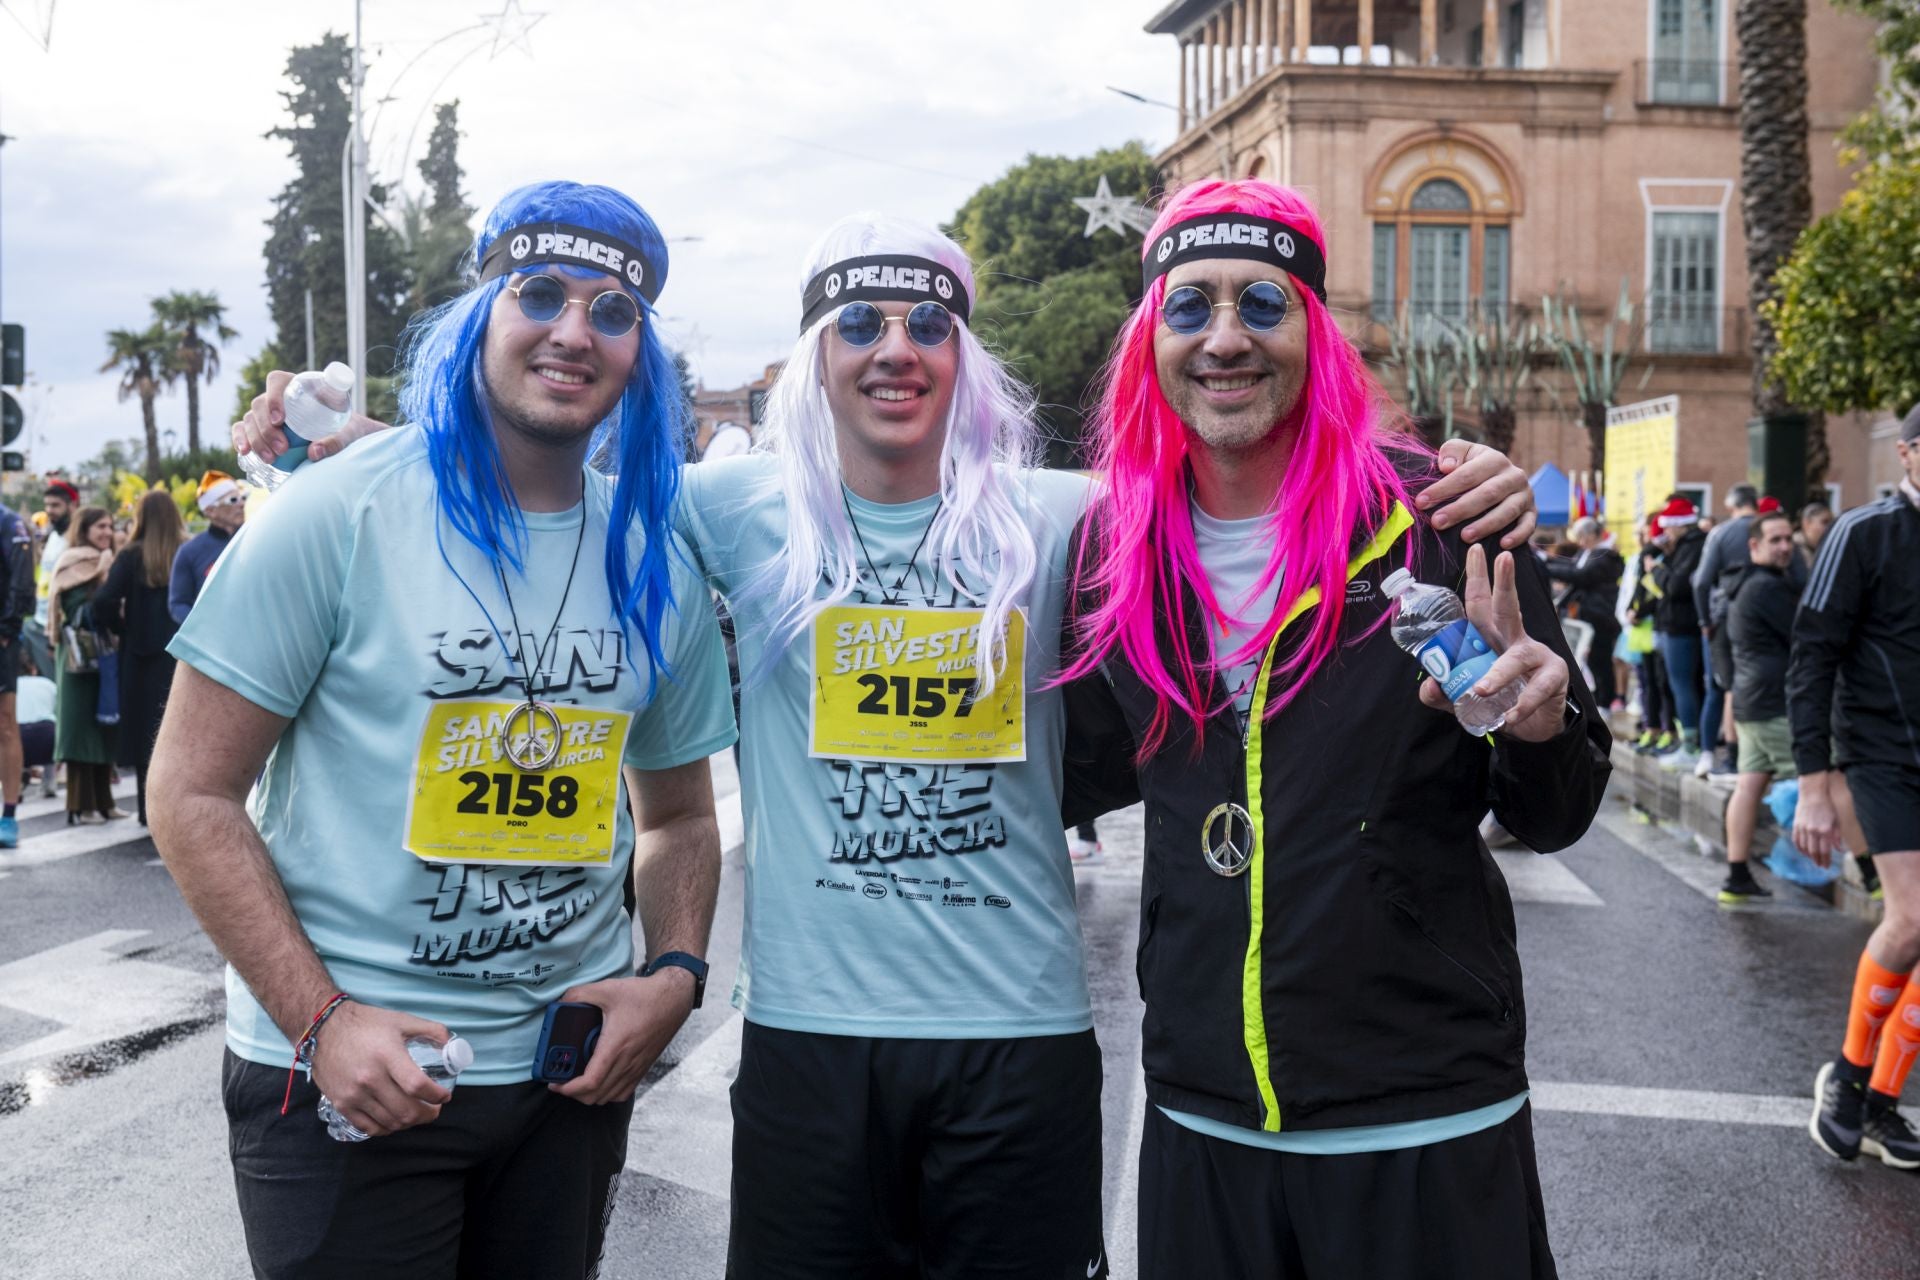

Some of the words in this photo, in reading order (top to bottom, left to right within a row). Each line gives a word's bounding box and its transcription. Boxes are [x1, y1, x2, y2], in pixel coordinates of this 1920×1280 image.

[535, 233, 624, 272] PEACE
[1178, 223, 1268, 251] PEACE
[846, 266, 930, 292] PEACE
[834, 616, 906, 648] SAN
[425, 627, 622, 698] SAN
[1425, 653, 1445, 678] U
[857, 673, 983, 718] 2157
[548, 747, 604, 770] URCIA
[456, 771, 578, 819] 2158
[829, 762, 997, 820] TRE
[830, 815, 1007, 864] MURCIA
[409, 889, 598, 966] MURCIA
